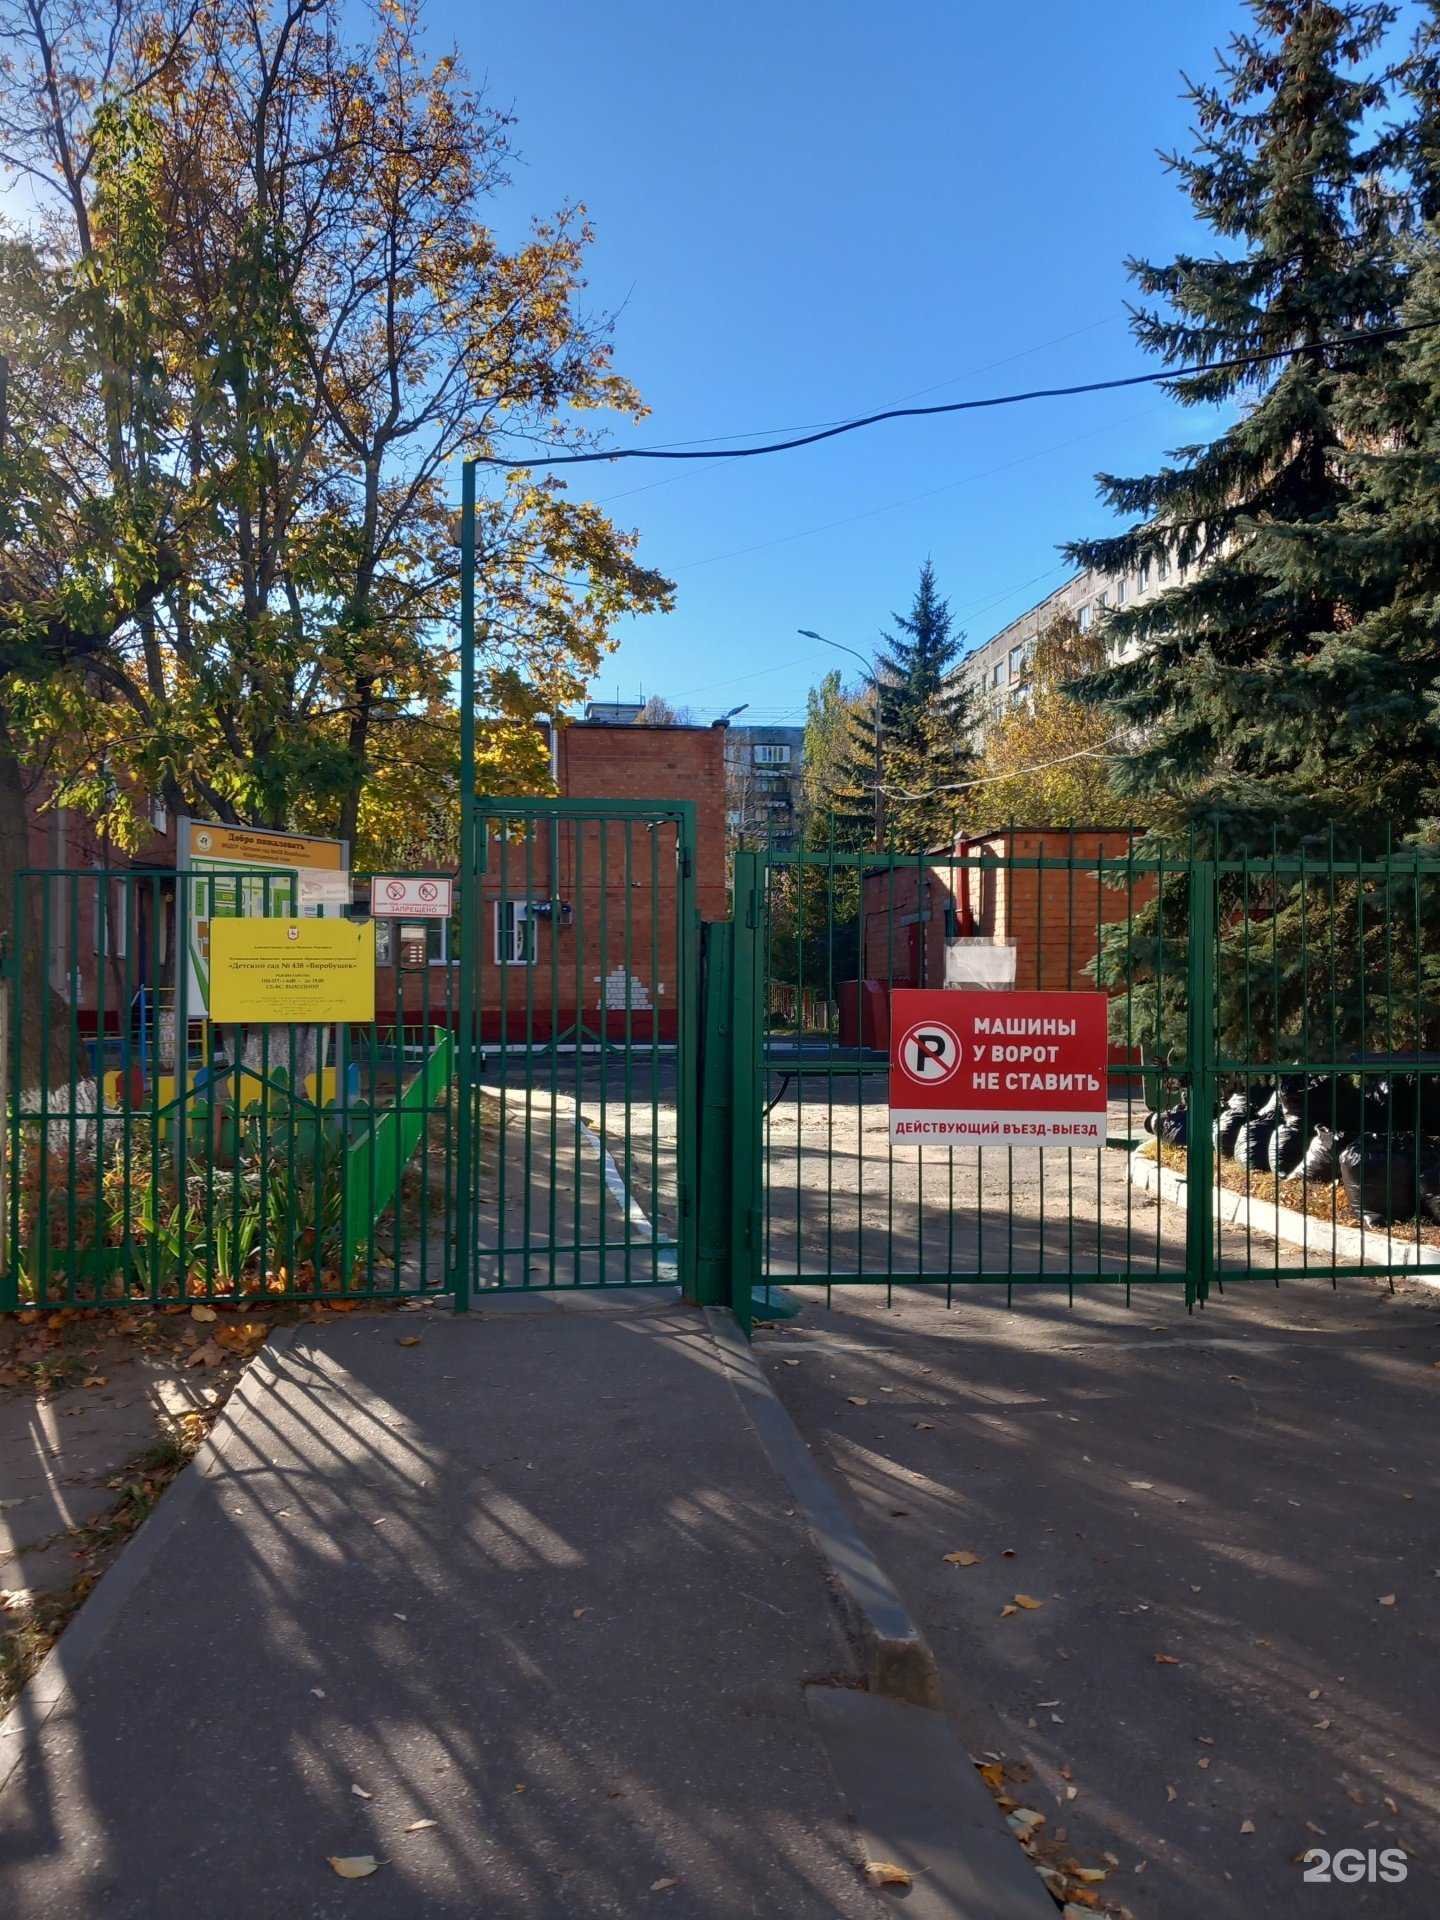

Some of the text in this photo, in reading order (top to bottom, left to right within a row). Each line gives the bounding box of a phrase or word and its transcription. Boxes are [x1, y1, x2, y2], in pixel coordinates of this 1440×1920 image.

[974, 1018, 1076, 1036] МАШИНЫ
[973, 1045, 1059, 1063] У ВОРОТ
[972, 1073, 1100, 1091] НЕ СТАВИТЬ
[895, 1121, 1098, 1137] ДЕЙСТВУЮЩИЙ ВЪЕЗД-ВЫЕЗД
